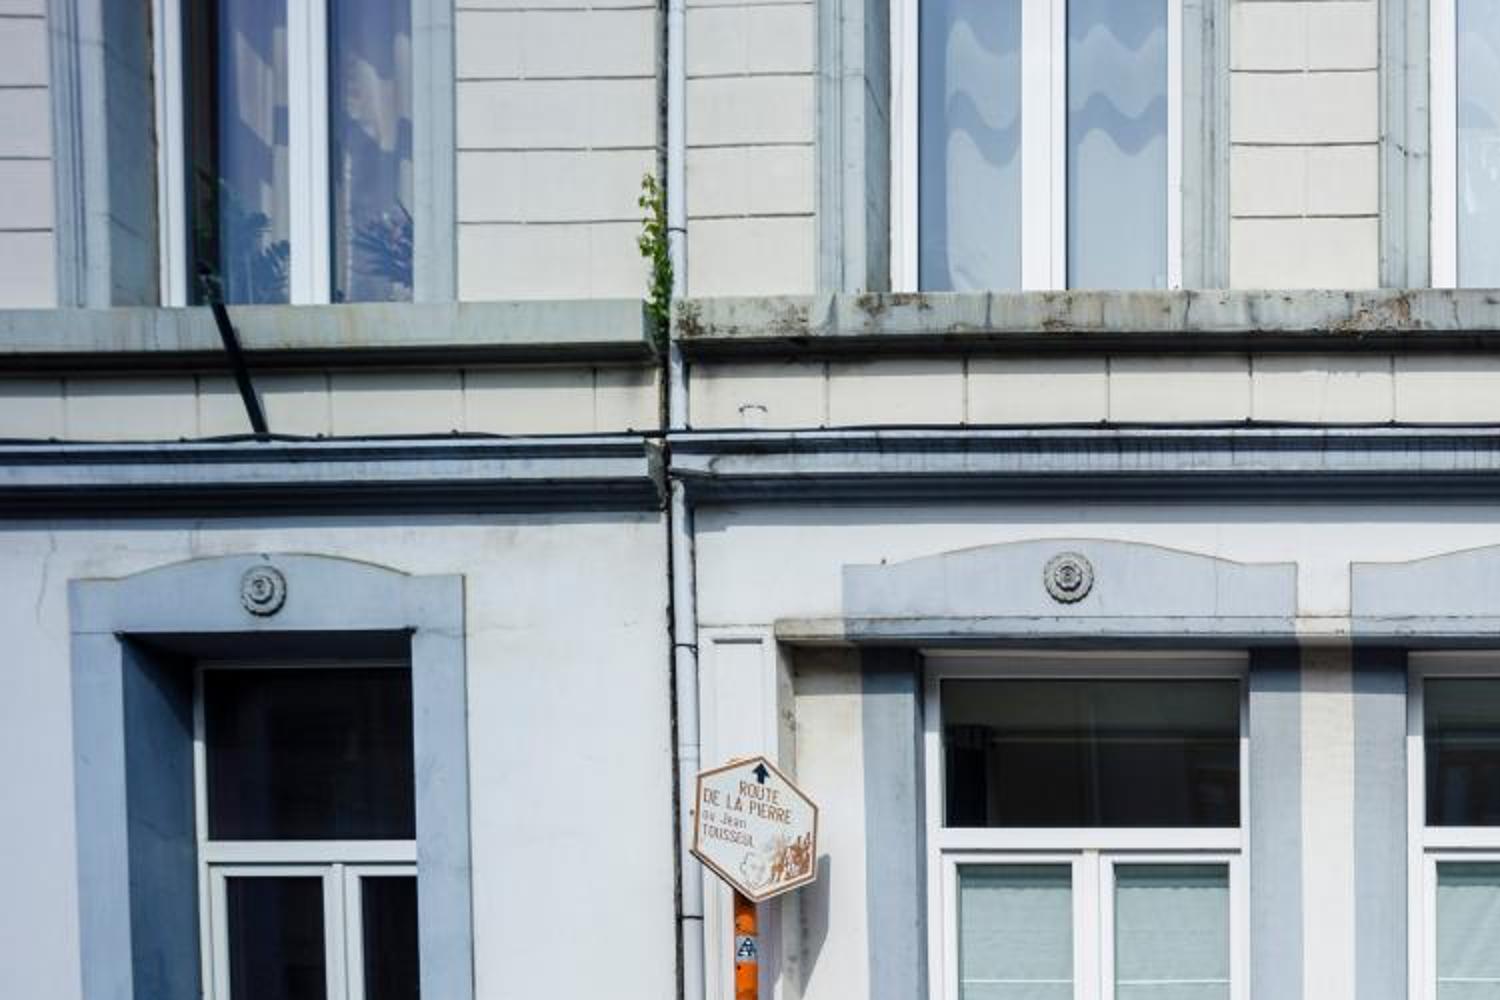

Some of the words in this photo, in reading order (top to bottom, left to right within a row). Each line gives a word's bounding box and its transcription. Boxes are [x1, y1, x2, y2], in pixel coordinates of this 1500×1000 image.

[739, 781, 779, 805] ROUTE
[703, 787, 720, 807] DE
[726, 791, 743, 812] LA
[749, 801, 791, 824] PIERRE
[720, 812, 747, 829] Jean
